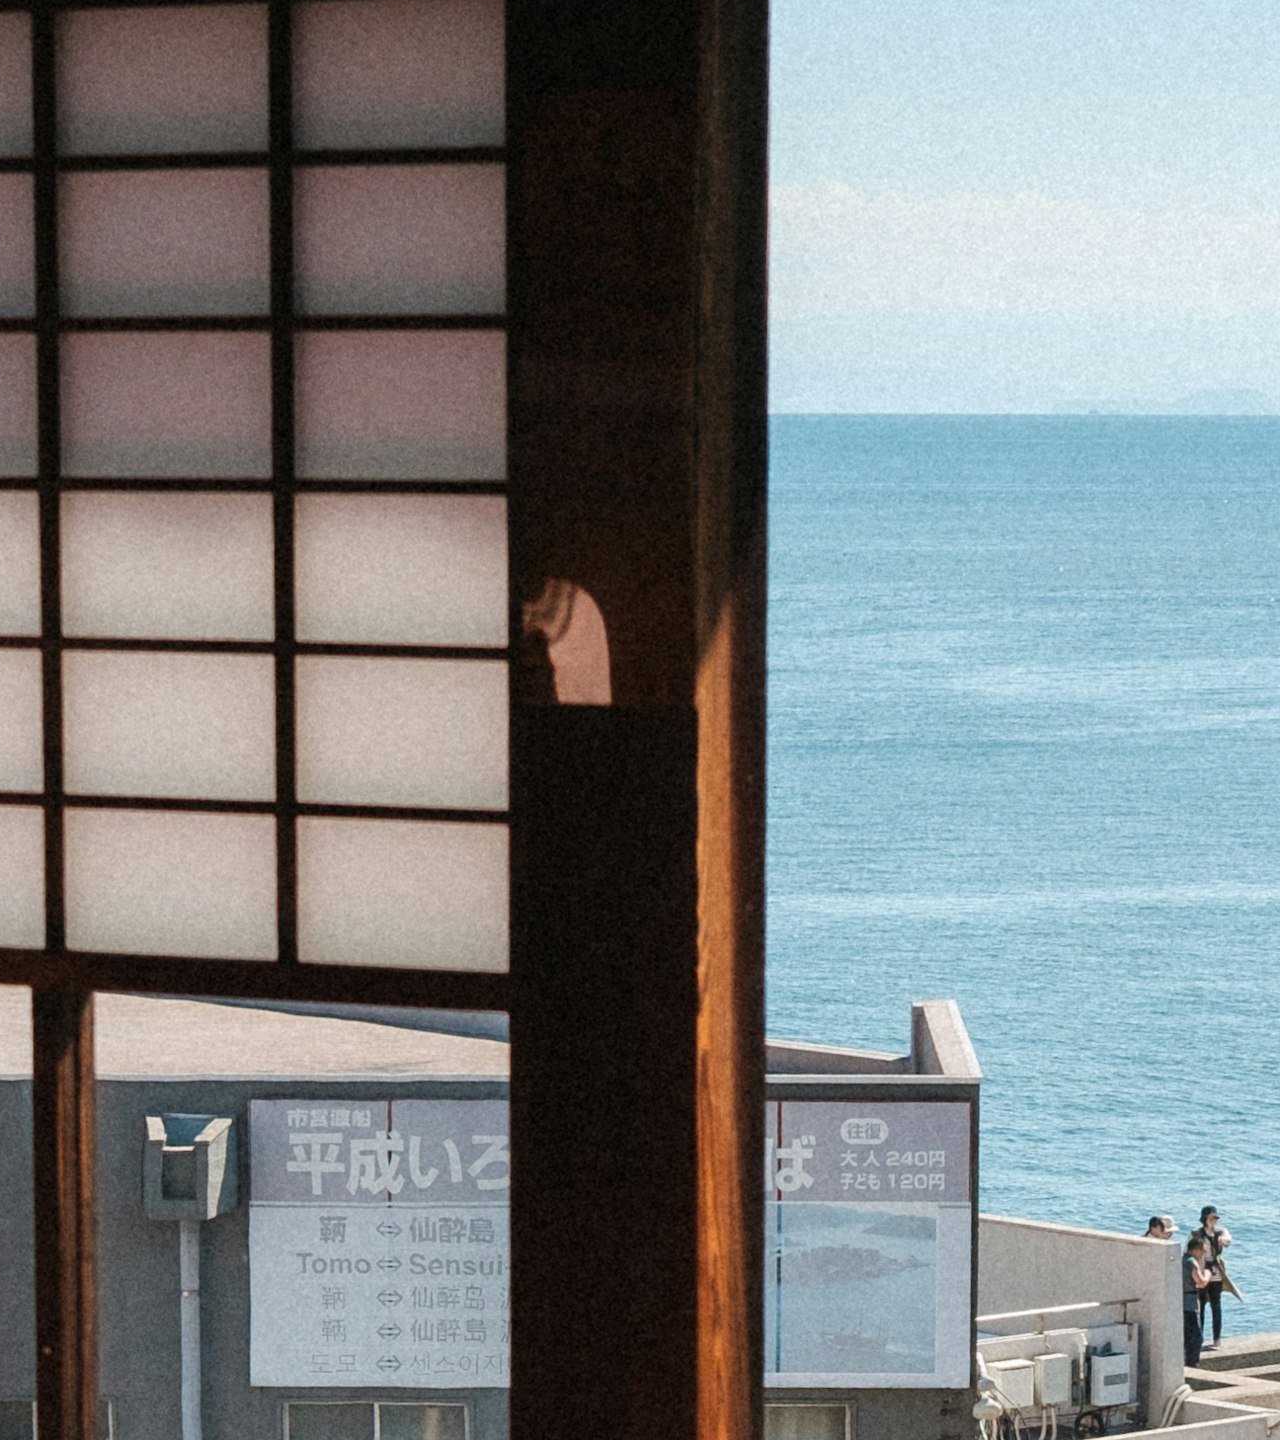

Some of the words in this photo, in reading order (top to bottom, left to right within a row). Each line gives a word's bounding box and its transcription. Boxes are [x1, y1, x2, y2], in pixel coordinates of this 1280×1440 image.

[286, 1108, 372, 1128] 市営渡船
[847, 1122, 882, 1140] 往復
[886, 1150, 946, 1167] 240円
[840, 1173, 880, 1190] 子ども
[889, 1173, 946, 1190] 120円
[296, 1253, 371, 1276] Tomo
[309, 1353, 358, 1374] 도모
